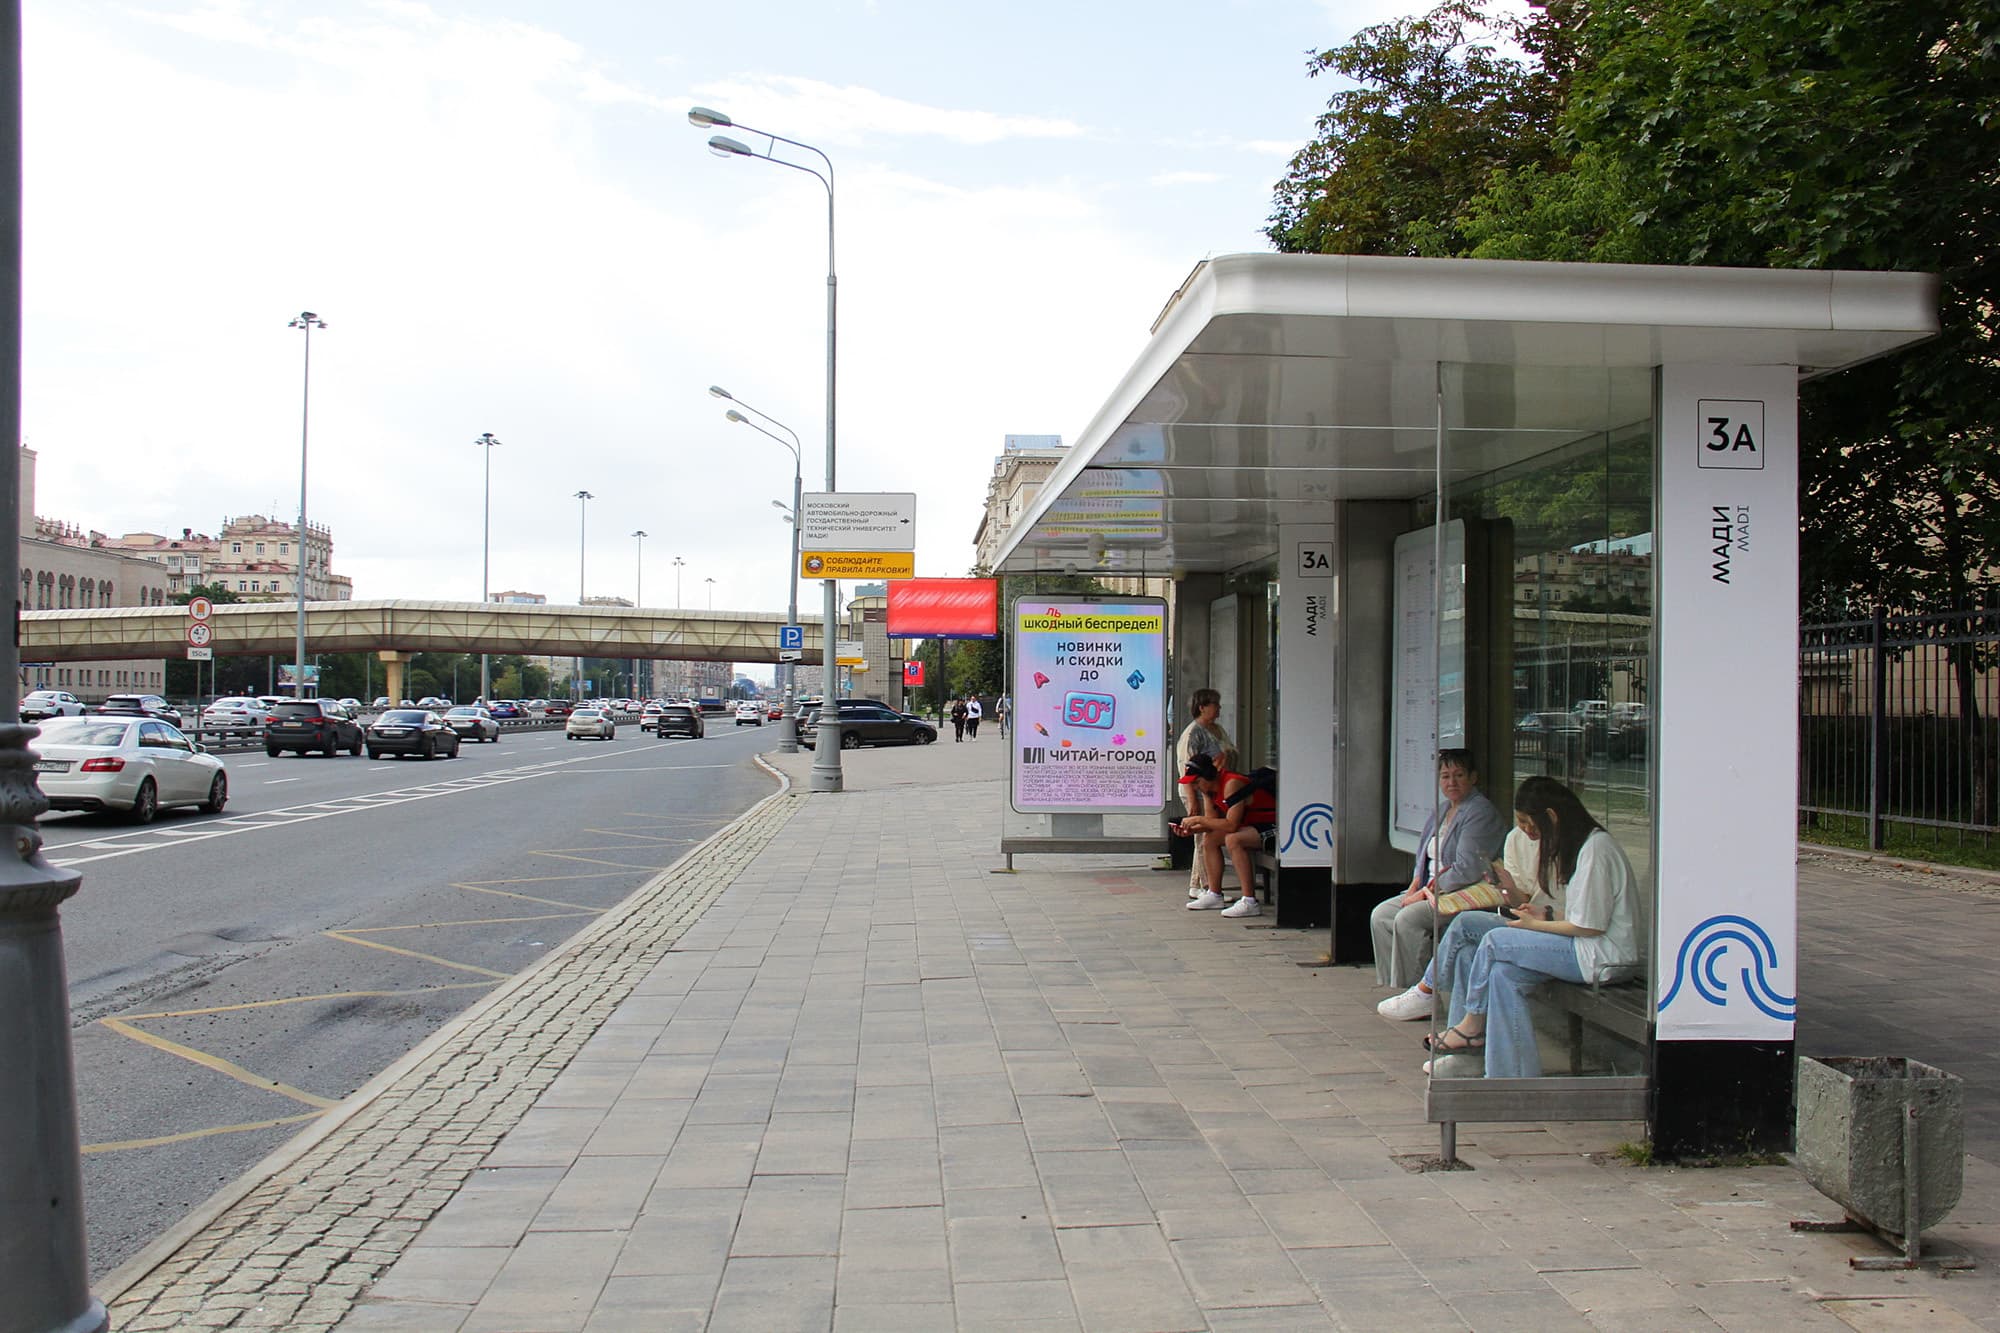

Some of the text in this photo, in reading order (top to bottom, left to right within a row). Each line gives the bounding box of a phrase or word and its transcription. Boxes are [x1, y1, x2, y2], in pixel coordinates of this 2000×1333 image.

[1736, 505, 1750, 552] MADI
[1712, 506, 1734, 585] МАДИ
[826, 557, 883, 565] СОБЛЮДАЙТЕ
[864, 566, 911, 574] ПАРКОВКИ!
[1306, 596, 1318, 636] МАДИ
[1085, 618, 1158, 632] беспредел!
[1057, 641, 1122, 652] новинки
[1056, 656, 1123, 667] и скидки
[1080, 670, 1099, 682] до
[1050, 747, 1157, 764] ЧИТАЙ-ГОРОД
